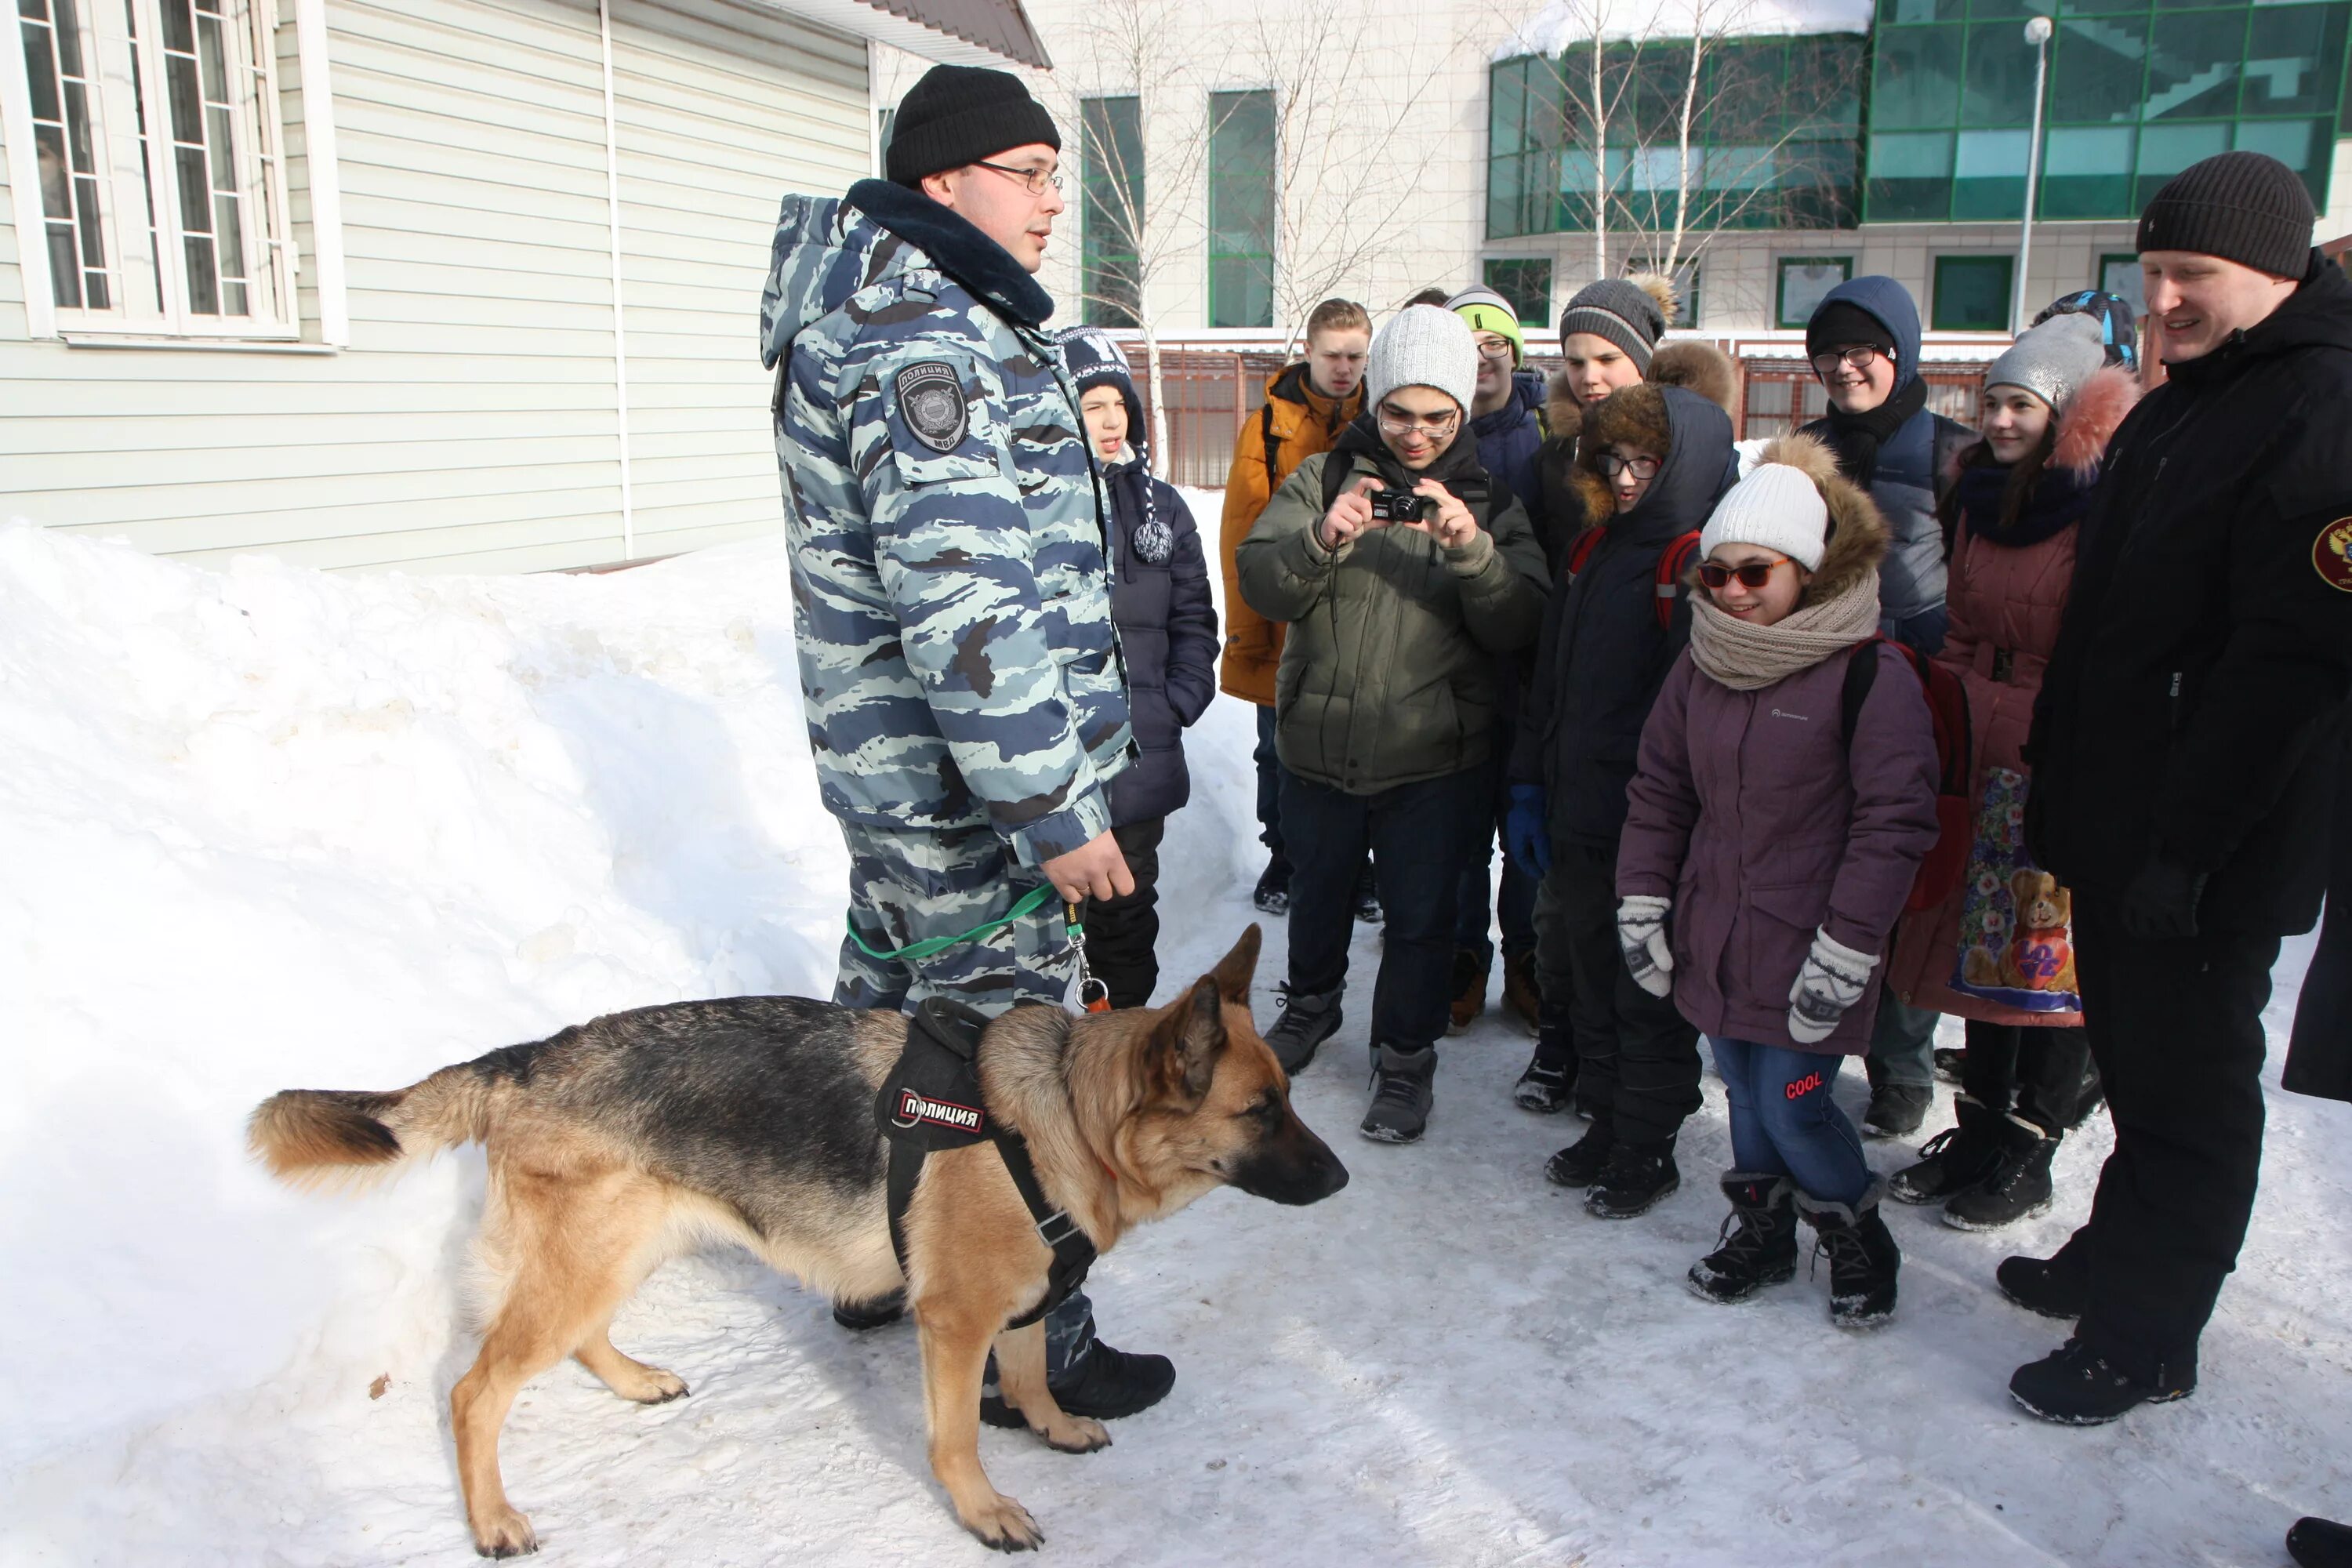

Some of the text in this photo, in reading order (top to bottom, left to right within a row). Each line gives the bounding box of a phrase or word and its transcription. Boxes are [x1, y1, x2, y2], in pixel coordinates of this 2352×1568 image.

[902, 366, 949, 386] ПОЛИЦИЯ
[934, 436, 956, 448] МВД
[1786, 1071, 1823, 1099] COOL
[906, 1098, 978, 1127] ПОЛИЦИЯ
